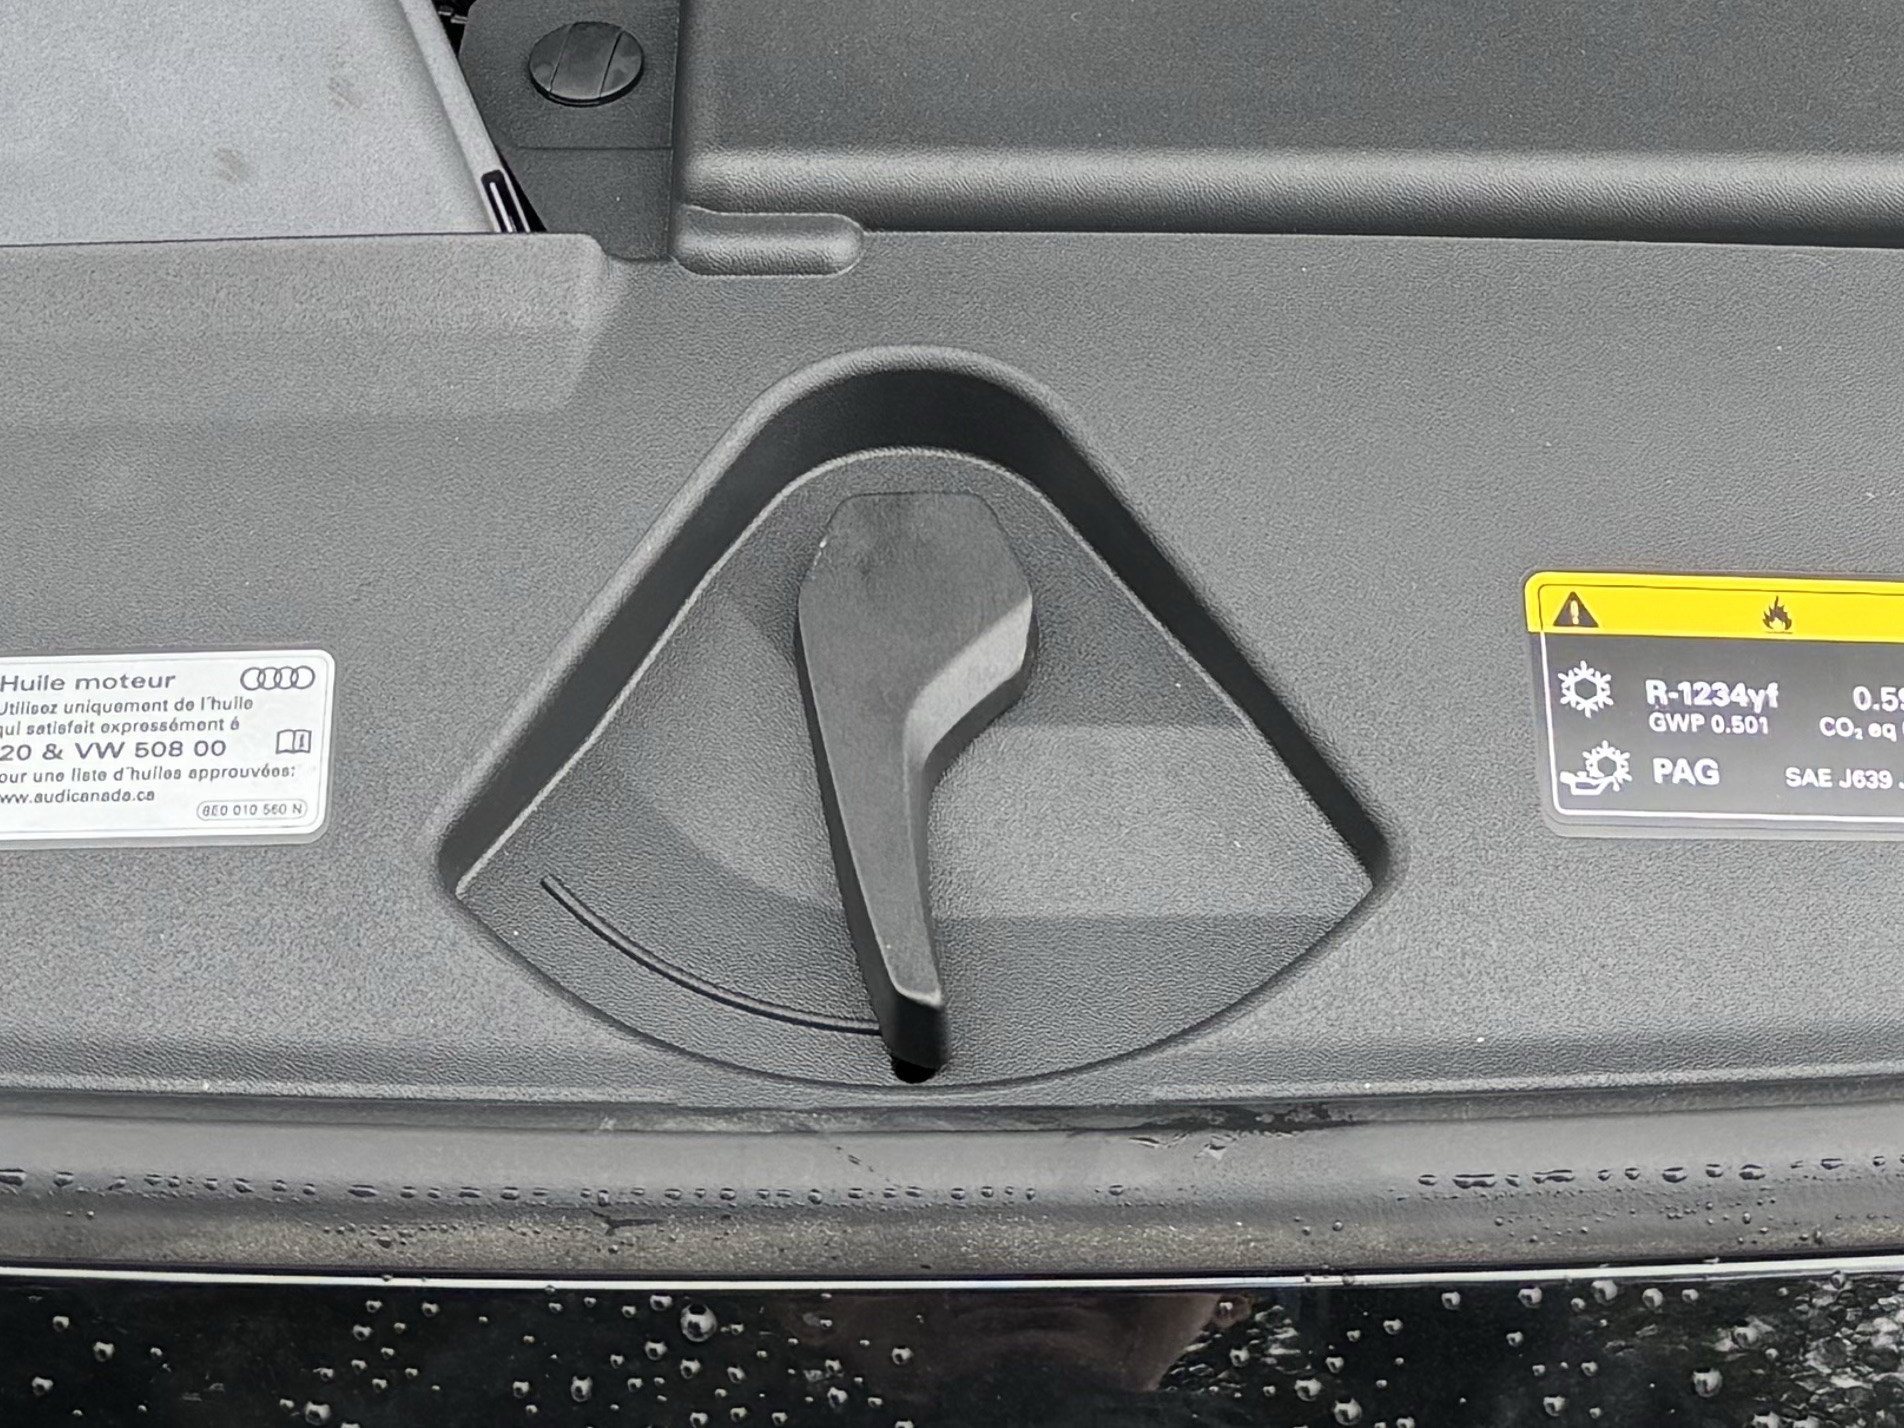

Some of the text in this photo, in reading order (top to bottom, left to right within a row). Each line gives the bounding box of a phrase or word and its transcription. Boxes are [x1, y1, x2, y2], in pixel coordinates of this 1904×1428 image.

[0, 673, 177, 693] Huile moteur
[63, 698, 169, 717] uniquement
[174, 697, 195, 713] de
[1646, 679, 1779, 715] R-1234yf
[26, 719, 96, 736] satisfait
[100, 716, 226, 735] expressément
[1648, 711, 1770, 735] GWP 0.501
[1868, 721, 1898, 743] eq
[42, 743, 64, 762] &
[74, 741, 126, 760] VW
[134, 740, 184, 759] 508
[193, 739, 227, 757] 00
[33, 770, 65, 783] une
[70, 767, 108, 782] liste
[188, 763, 297, 783] approuvées:
[1652, 757, 1721, 786] PAG
[1785, 767, 1834, 789] SAE
[1838, 768, 1893, 790] J639
[233, 805, 258, 817] 010
